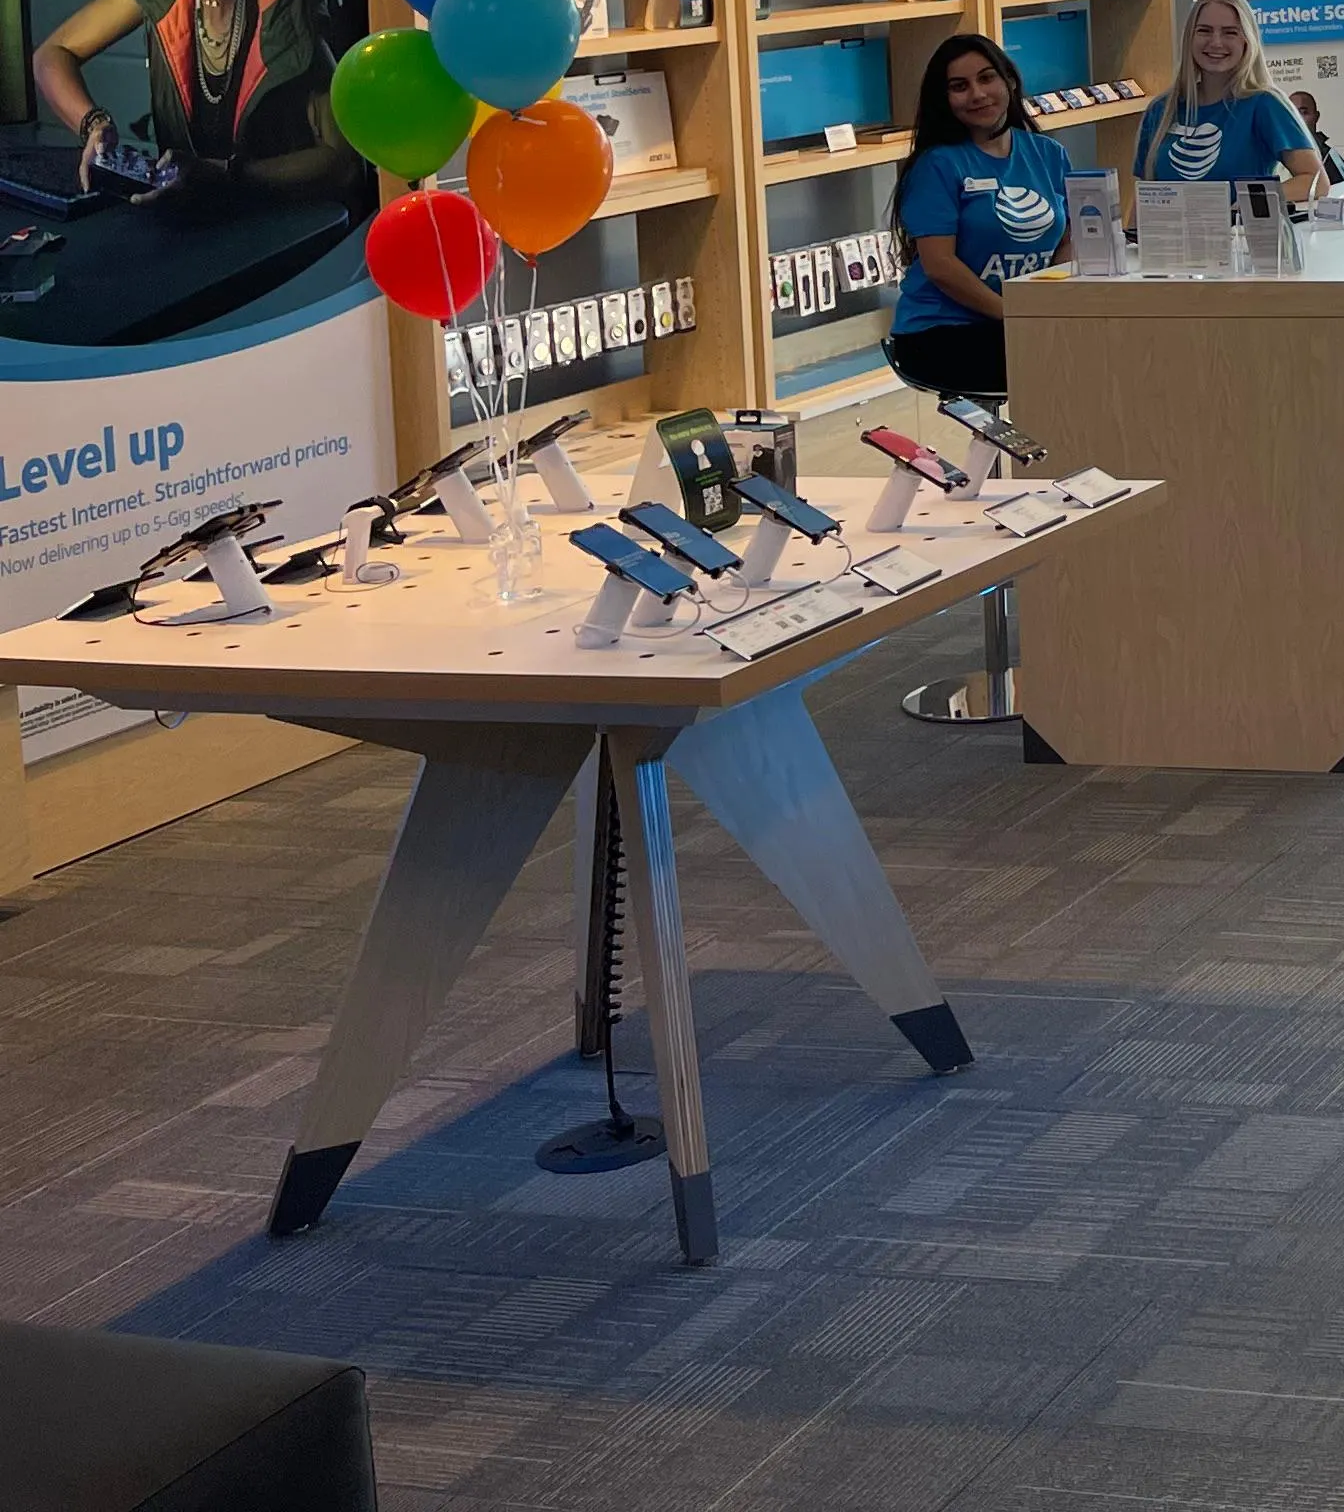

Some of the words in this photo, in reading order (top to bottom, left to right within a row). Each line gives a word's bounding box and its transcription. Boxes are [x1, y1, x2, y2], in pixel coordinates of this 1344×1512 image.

[1283, 57, 1304, 66] HERE
[980, 251, 1055, 282] AT&T
[0, 425, 116, 502] Level
[129, 421, 185, 471] up
[0, 509, 68, 548] Fastest
[72, 490, 150, 528] Internet.
[154, 446, 291, 503] Straightforward
[295, 434, 353, 468] pricing.
[0, 554, 35, 577] Now
[38, 531, 110, 566] delivering
[112, 526, 132, 547] up
[134, 520, 151, 537] to
[152, 508, 192, 532] 5-Gig
